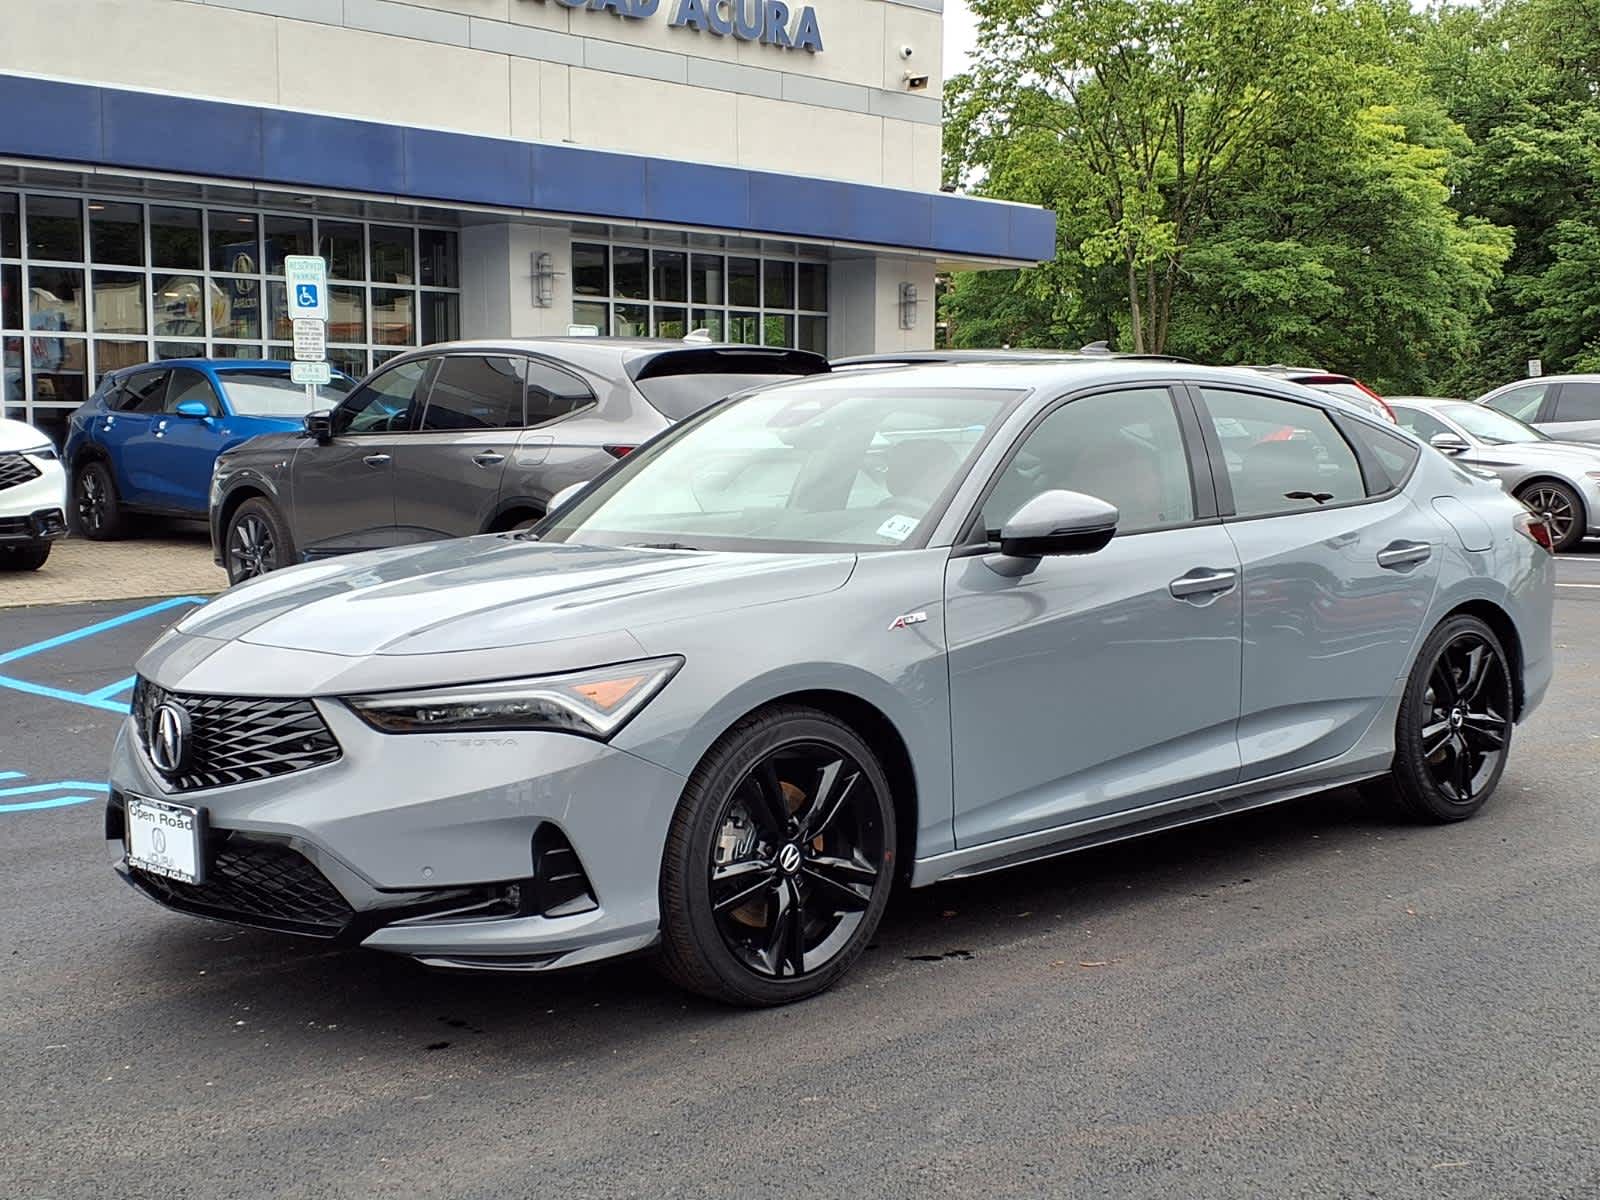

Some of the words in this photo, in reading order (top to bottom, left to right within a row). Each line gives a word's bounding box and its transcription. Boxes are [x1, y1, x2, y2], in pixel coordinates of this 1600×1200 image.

[669, 0, 824, 52] ACURA
[130, 803, 156, 822] Open
[159, 813, 192, 831] Road
